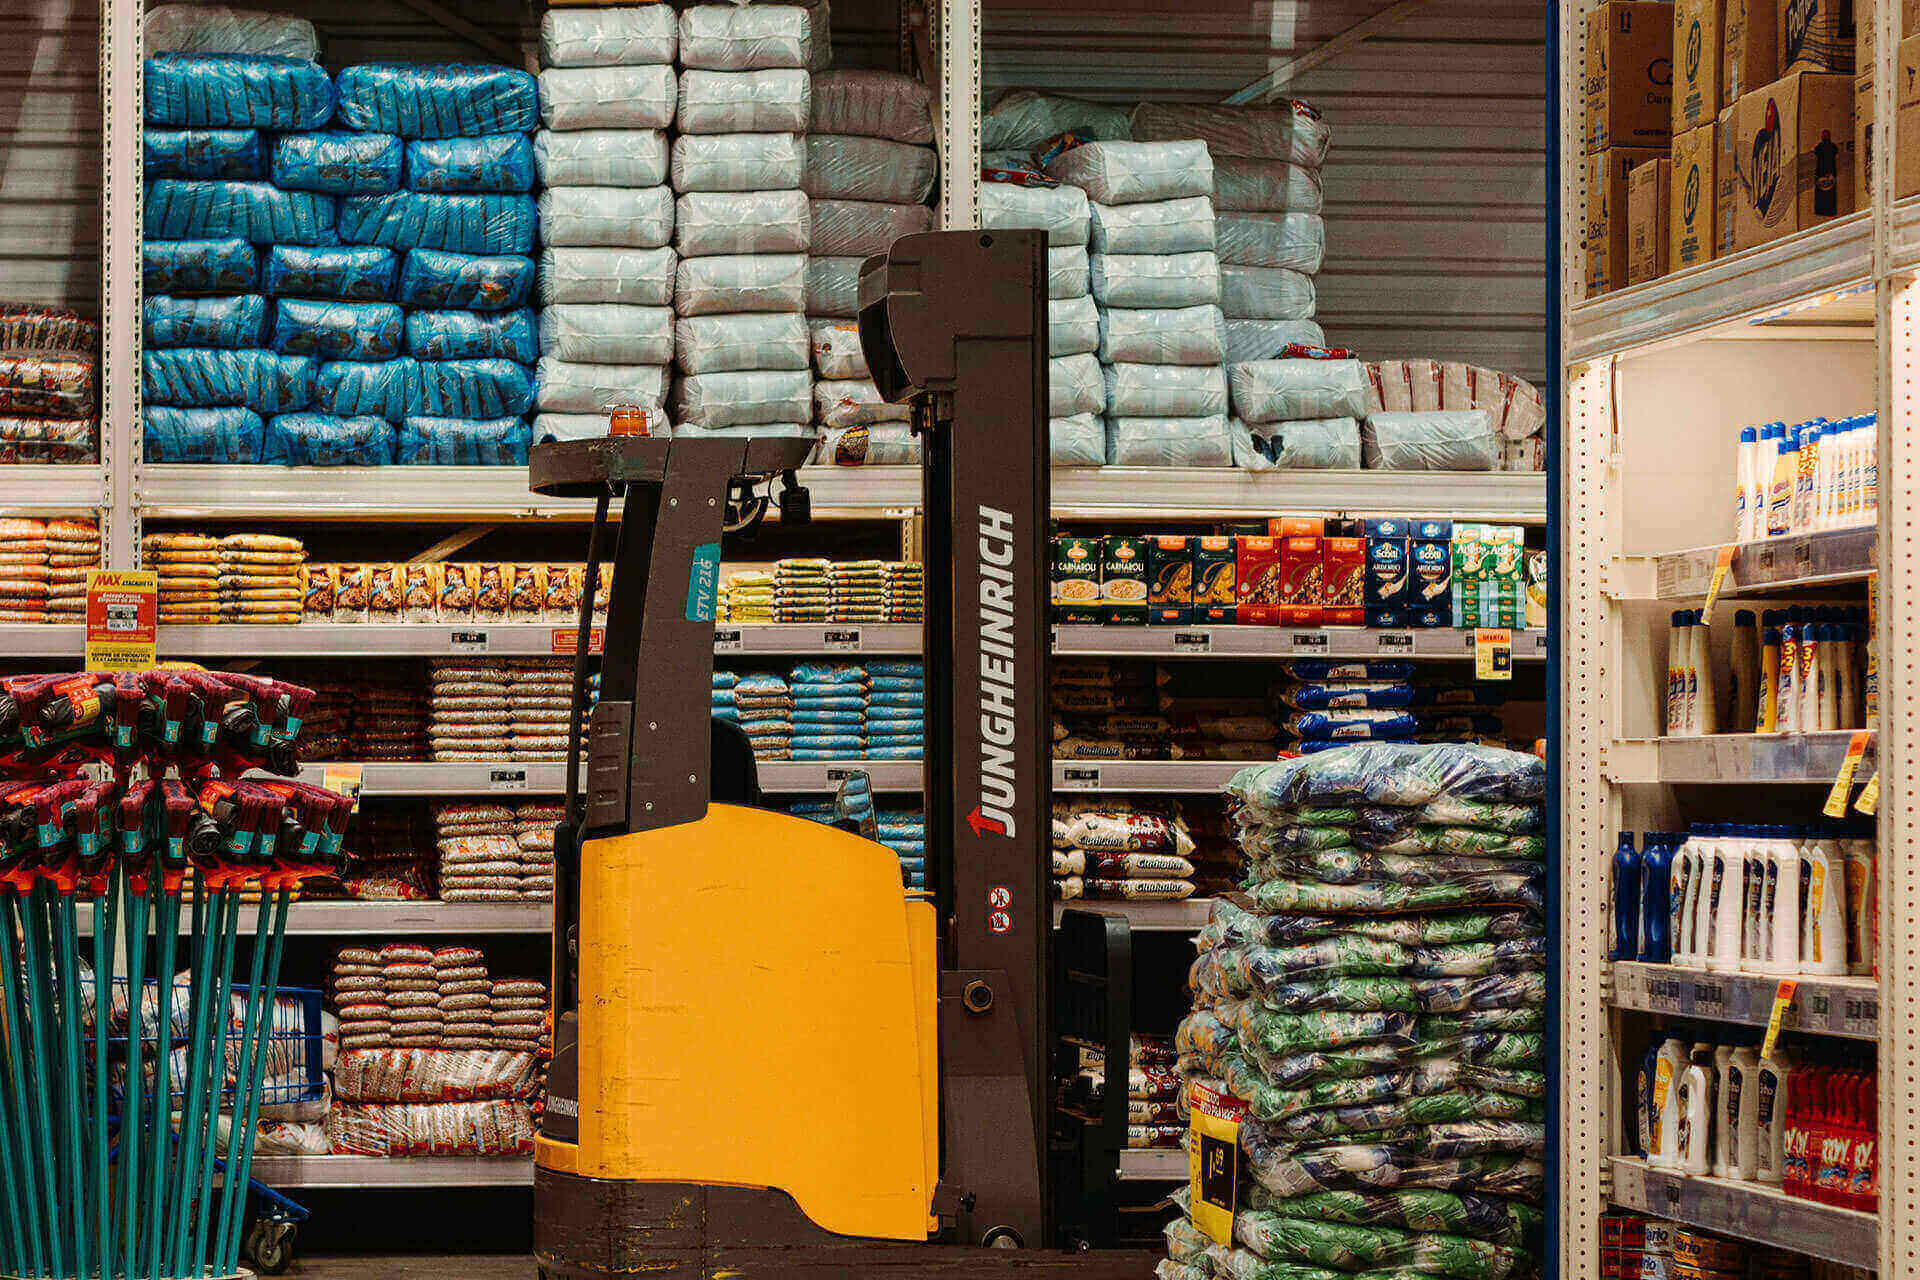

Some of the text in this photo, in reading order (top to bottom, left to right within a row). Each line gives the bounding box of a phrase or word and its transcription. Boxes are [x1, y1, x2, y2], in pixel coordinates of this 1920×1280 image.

[92, 574, 121, 589] MAX
[696, 558, 713, 621] ETV 216
[978, 504, 1016, 839] JUNGHEINRICH
